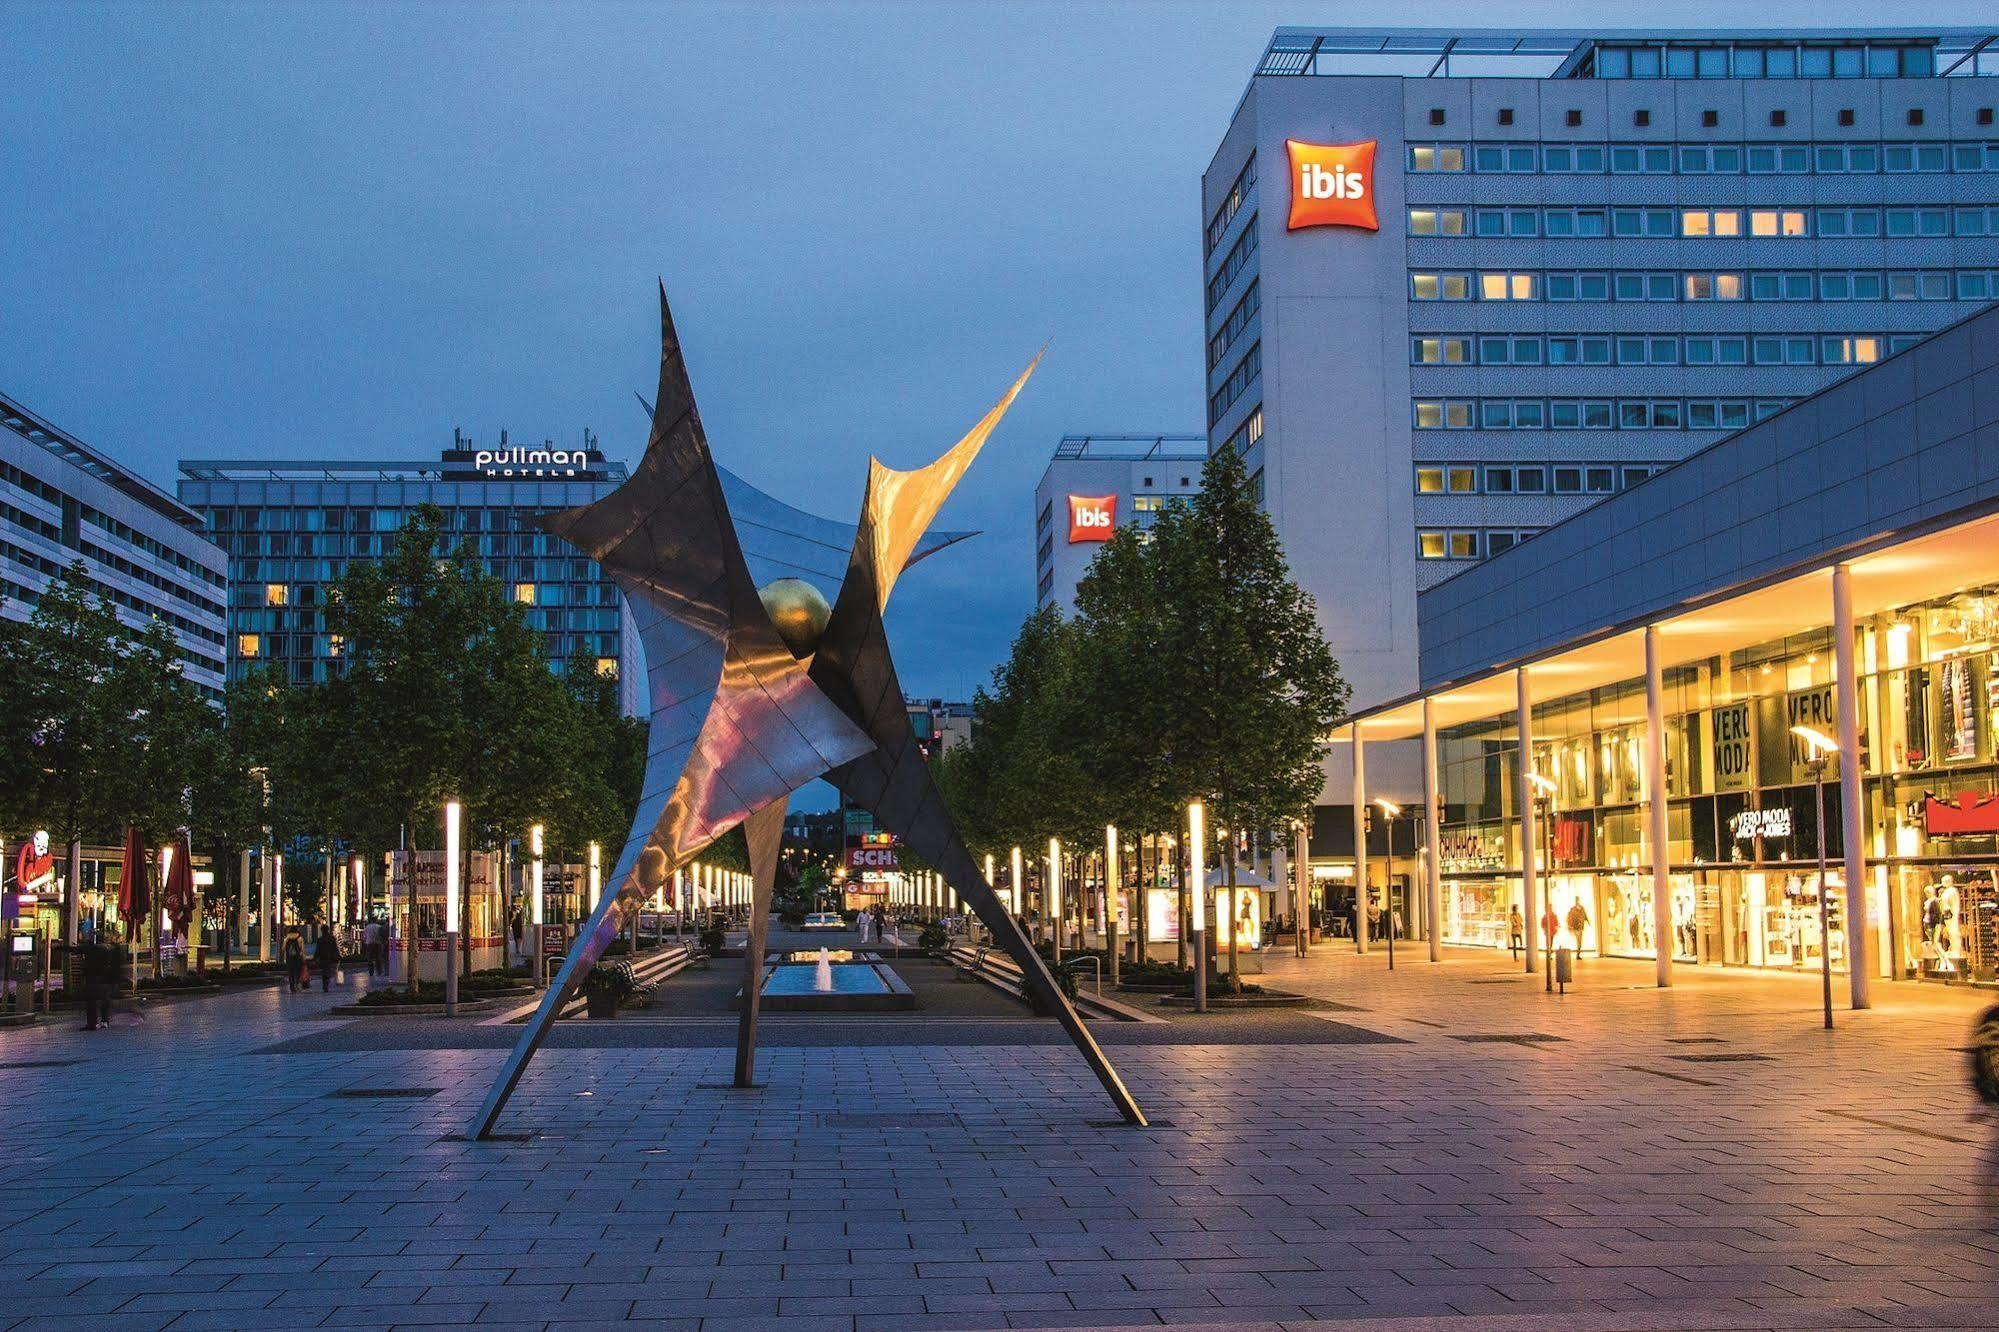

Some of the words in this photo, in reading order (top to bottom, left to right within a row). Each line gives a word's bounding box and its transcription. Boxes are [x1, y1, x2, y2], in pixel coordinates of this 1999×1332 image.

[1301, 163, 1364, 199] ibis
[476, 447, 587, 470] pullman
[1076, 506, 1111, 527] ibis
[1788, 690, 1832, 725] VERO
[1737, 810, 1761, 826] VERO
[1762, 807, 1790, 824] MODA
